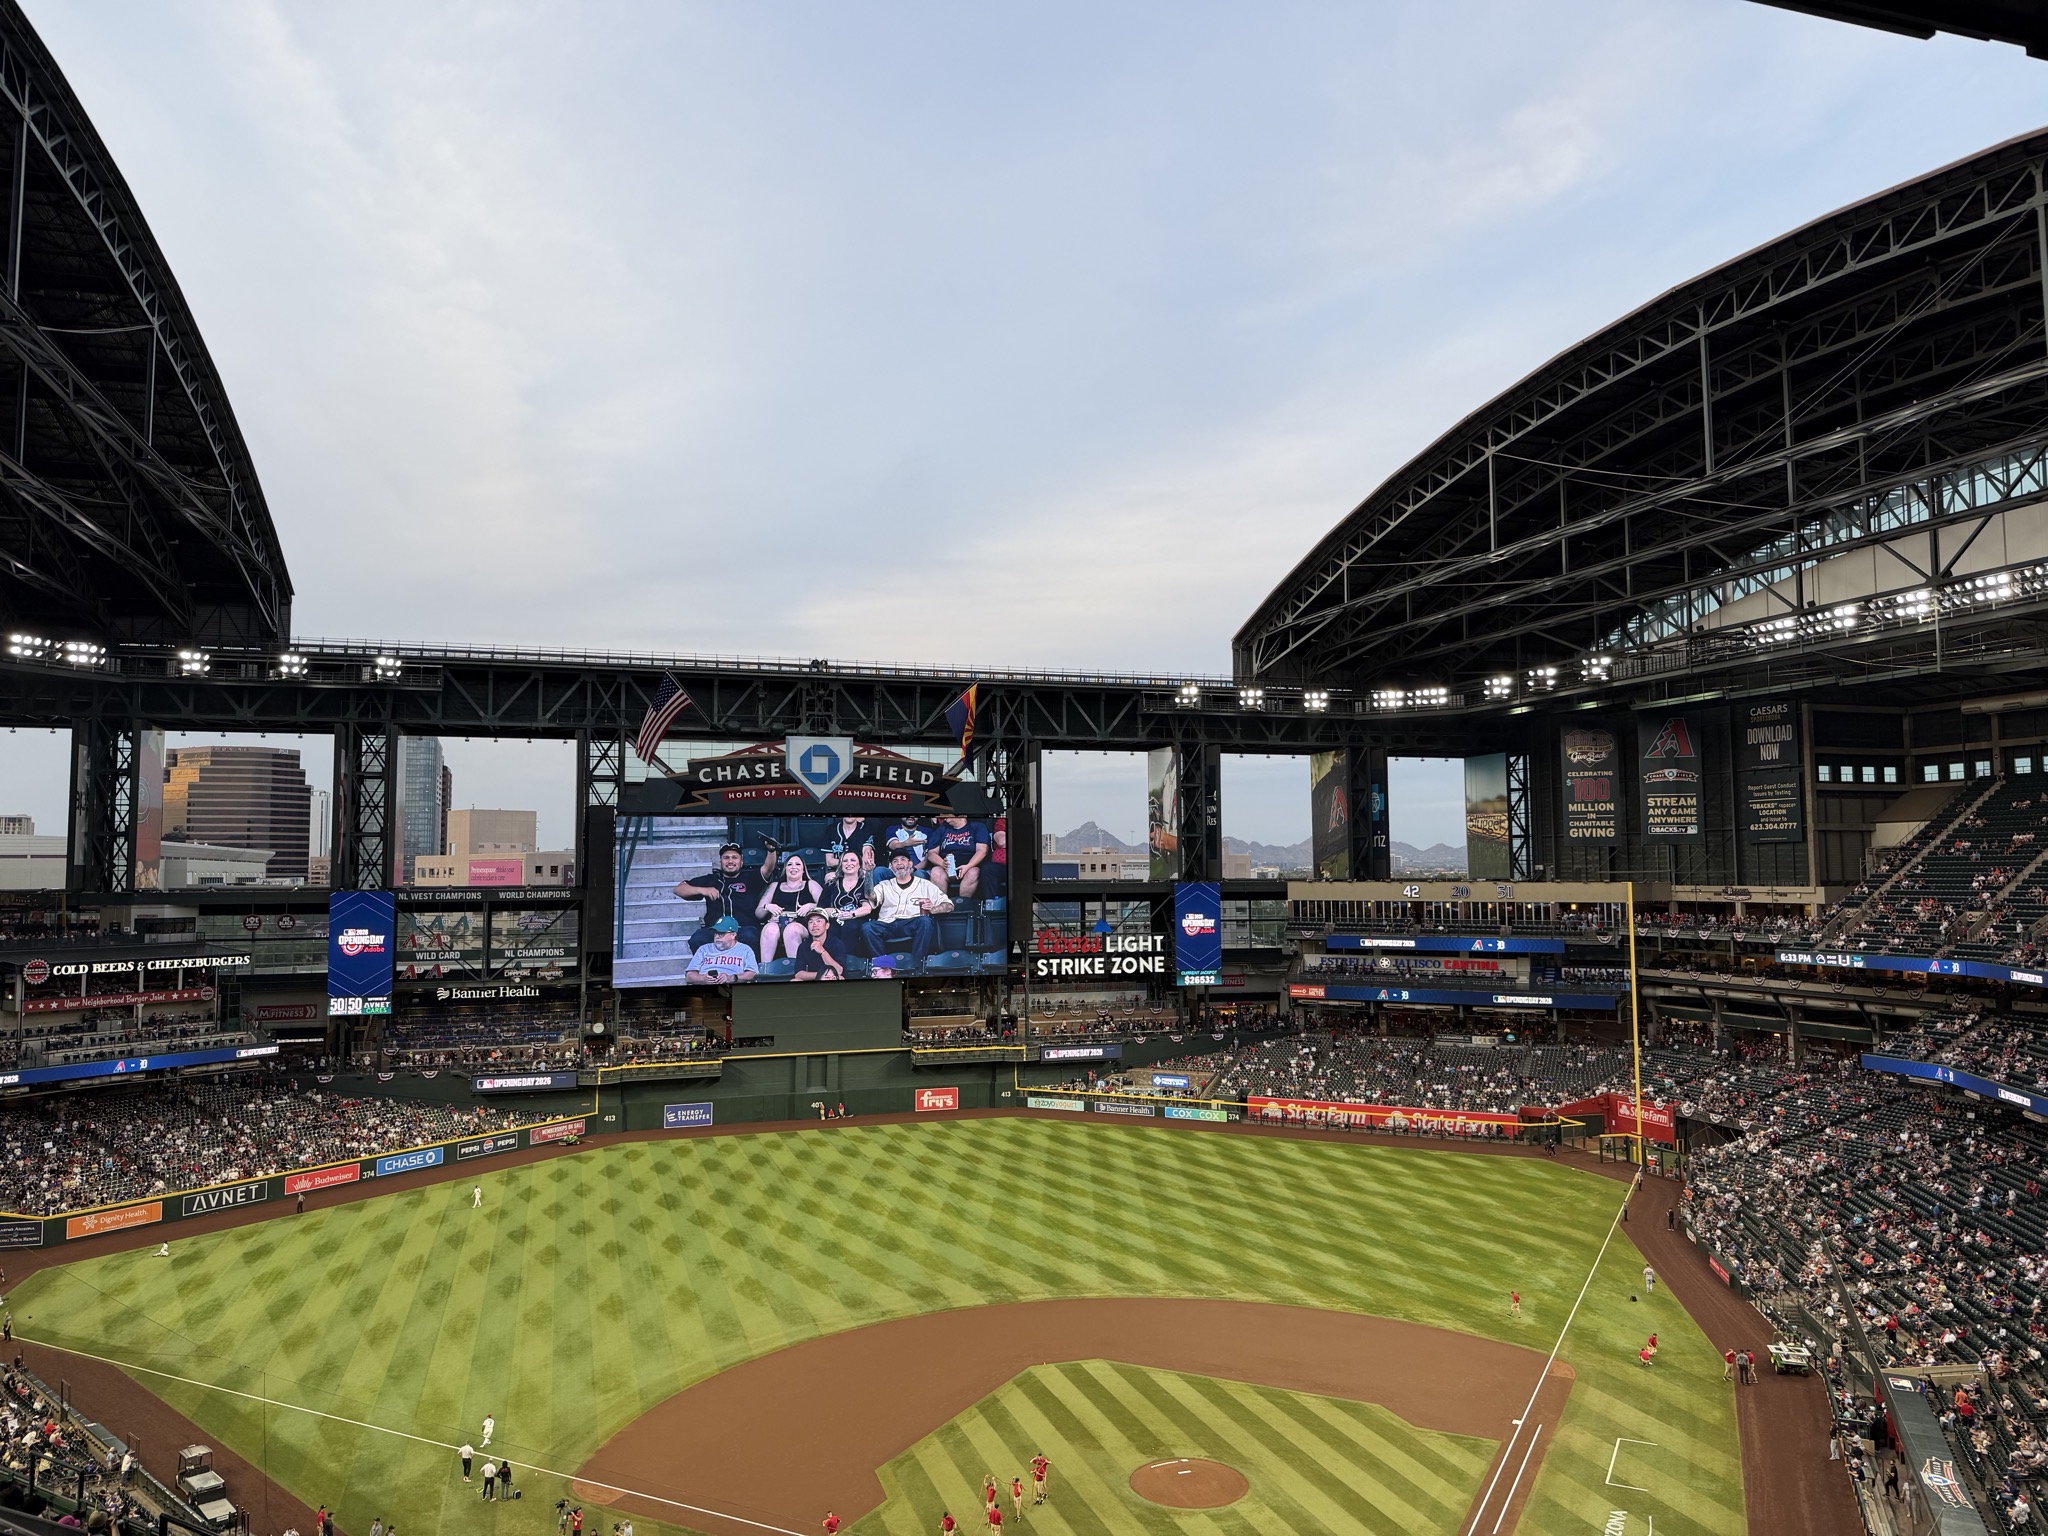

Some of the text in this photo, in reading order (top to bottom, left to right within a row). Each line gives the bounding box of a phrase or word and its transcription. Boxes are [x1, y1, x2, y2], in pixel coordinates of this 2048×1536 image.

[1750, 704, 1788, 716] CAESARS
[1747, 724, 1792, 744] DOWNLOAD
[1571, 752, 1587, 763] Give
[1760, 743, 1780, 761] NOW
[698, 762, 935, 786] CHASE FIELD
[1566, 777, 1610, 801] $100
[728, 790, 757, 799] HOME
[784, 789, 802, 797] THE
[837, 790, 908, 801] DIAMONDBACKS
[1647, 797, 1696, 806] STREAM
[1568, 803, 1614, 812] MILLION
[1468, 816, 1502, 834] Slugger
[1648, 816, 1697, 824] ANYWHERE
[1750, 823, 1797, 831] 623.304.0777
[1569, 828, 1616, 838] GIVING
[398, 892, 482, 900] NL WEST CHAMPIONS
[499, 890, 571, 899] WORLD CHAMPIONS
[1403, 885, 1514, 899] 42 20 51
[338, 935, 385, 945] OPENING DAY
[1036, 928, 1165, 954] Coors LIGHT
[416, 951, 461, 960] WILD CARD
[504, 948, 565, 958] NL CHAMPIONS
[1780, 953, 1812, 963] 6:33 PM
[53, 964, 89, 976] COLD
[92, 961, 135, 974] BEERS
[137, 961, 145, 971] &
[147, 955, 251, 970] CHEESEBURGERS
[1037, 956, 1165, 976] STRIKE ZONE
[1319, 957, 1499, 971] ESTRELLA JALISCO CANTINA
[1184, 975, 1215, 986] $26532
[452, 988, 497, 999] Banner
[64, 993, 166, 1009] Your Neighborhood Burger Joint
[271, 1010, 304, 1018] FITNESS
[1058, 1049, 1077, 1057] OPENING
[494, 1077, 551, 1088] OPENING DAY 2026
[920, 1091, 954, 1108] fry's
[1106, 1104, 1150, 1115] Banner Health
[1172, 1109, 1220, 1120] COX COX
[542, 1125, 568, 1135] MEMBERSHIPS
[461, 1145, 479, 1154] PEPSI
[497, 1138, 516, 1146] PEPSI
[385, 1156, 423, 1171] CHASE
[314, 1172, 353, 1185] Budweiser
[362, 1171, 375, 1179] 374
[192, 1184, 259, 1212] AVNET
[100, 1209, 148, 1224] Dignity Health
[1933, 1461, 1941, 1475] FIELD
[1941, 1486, 1956, 1502] CHASE
